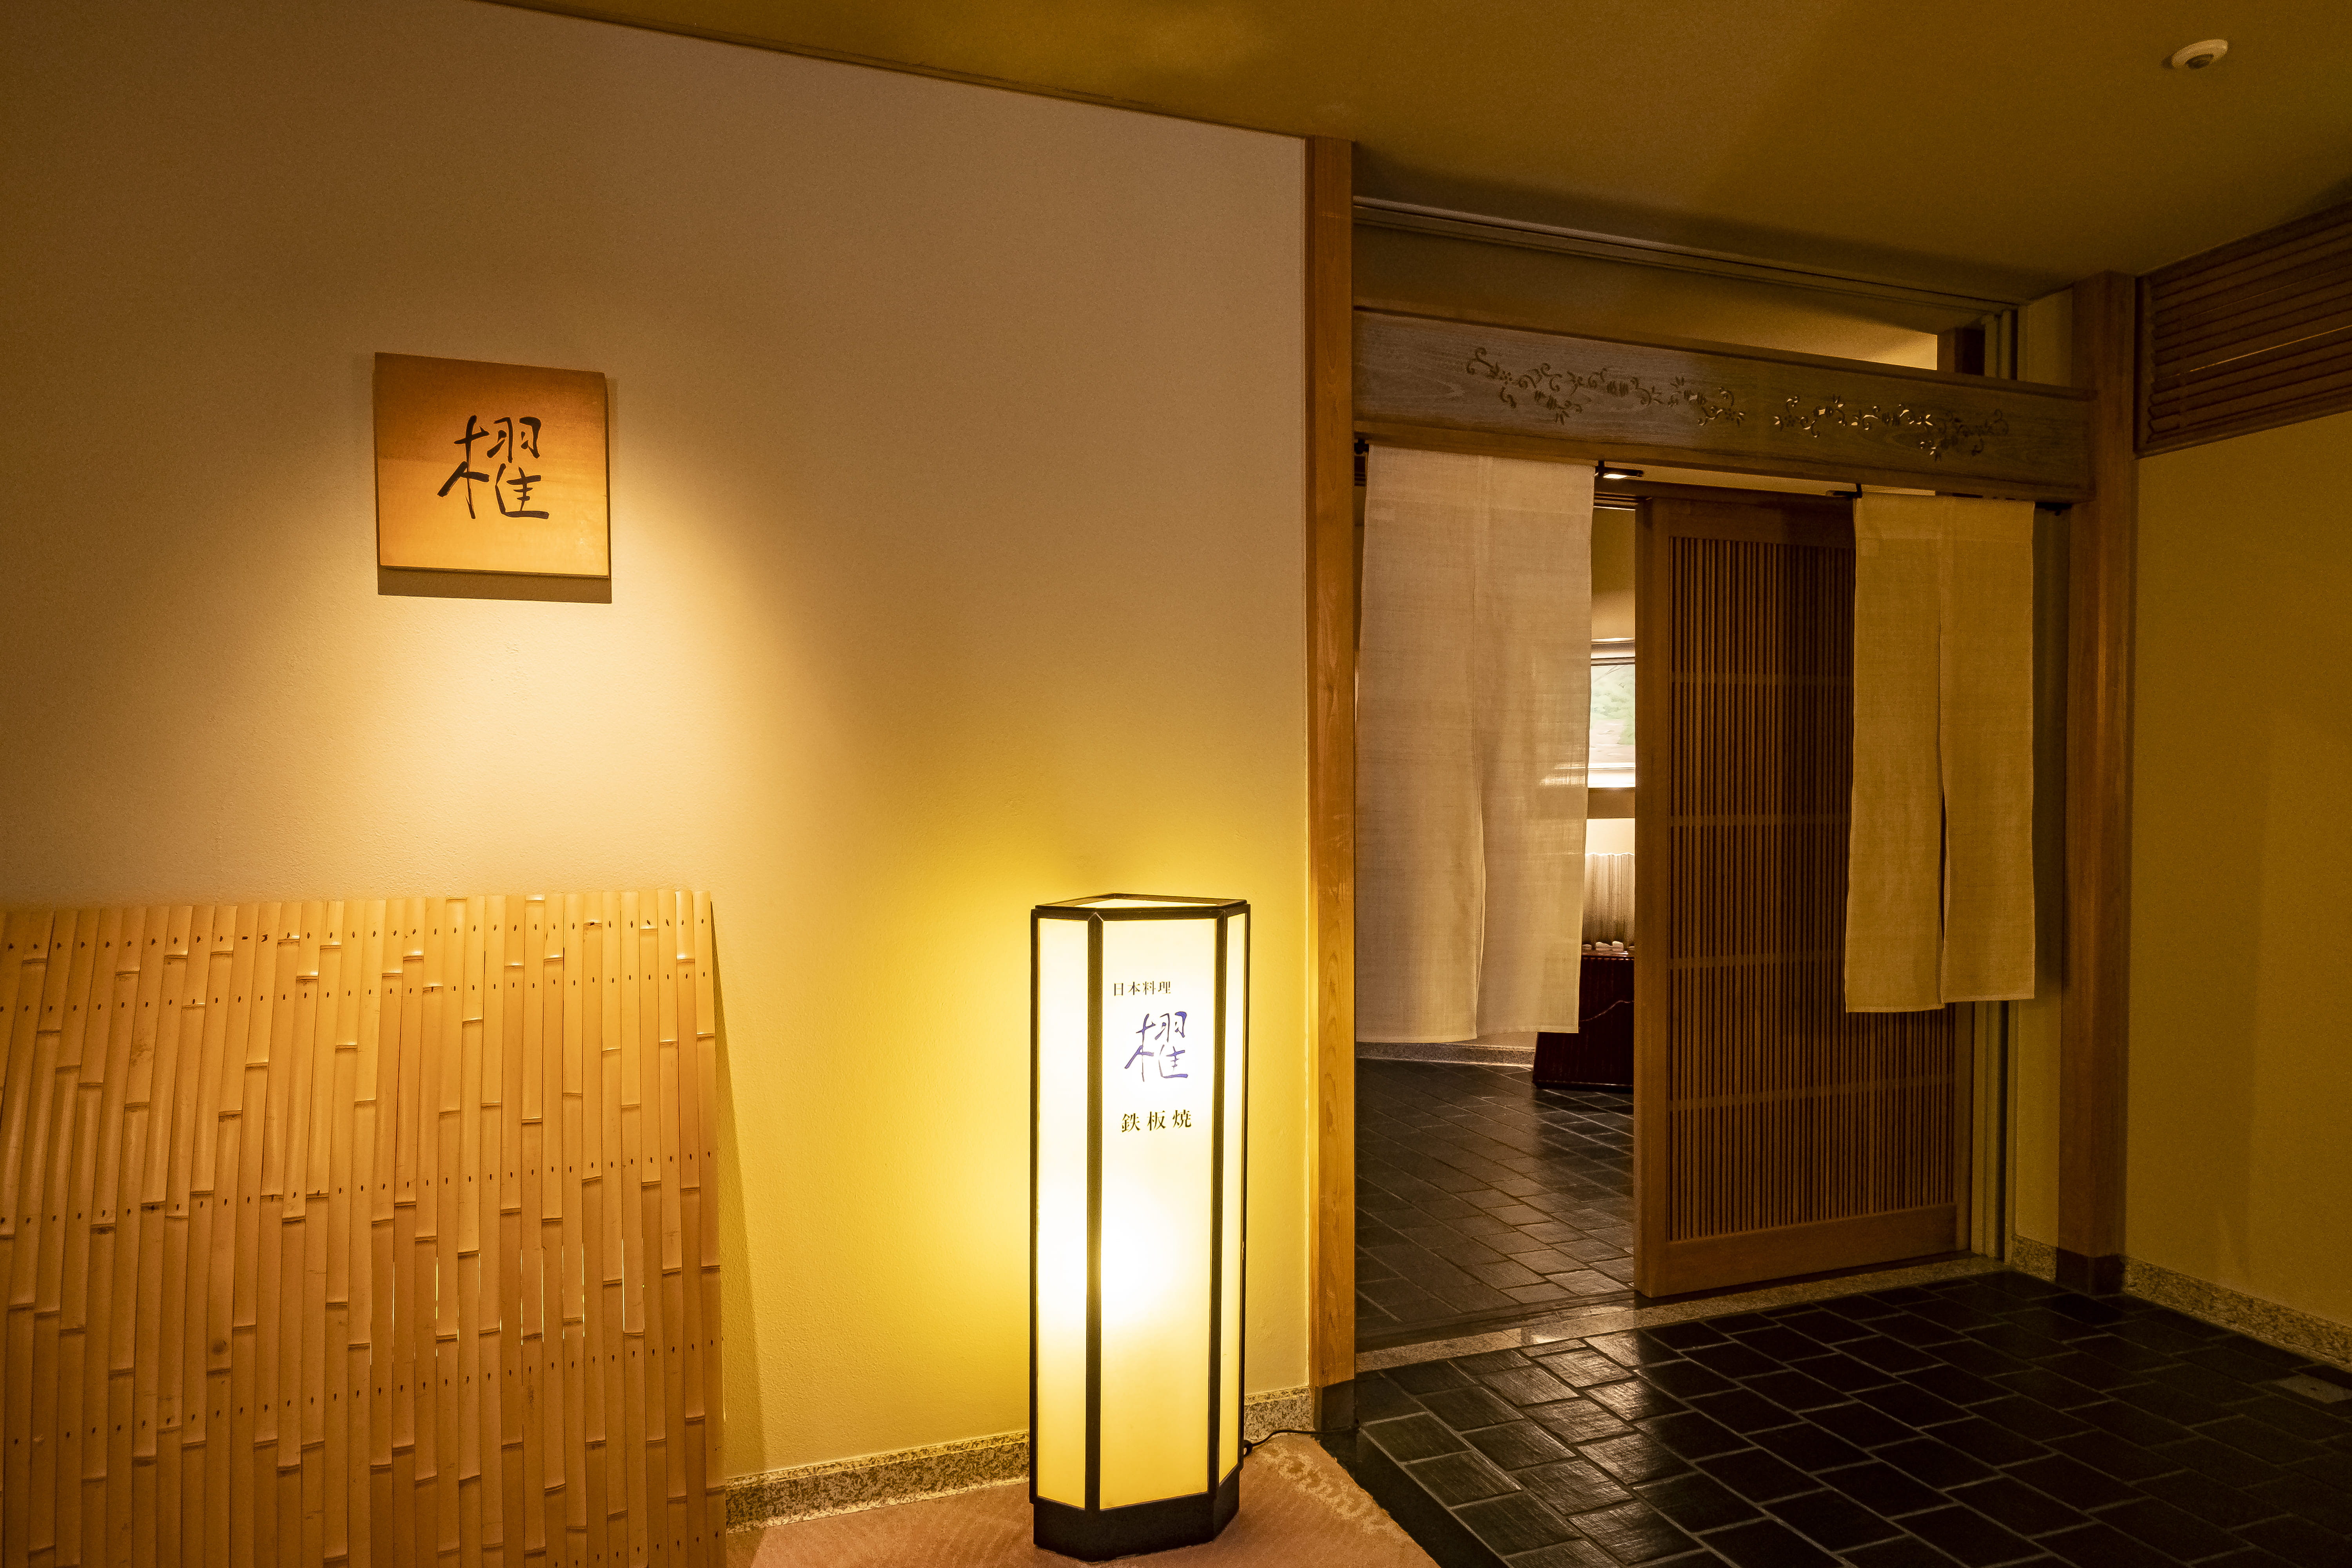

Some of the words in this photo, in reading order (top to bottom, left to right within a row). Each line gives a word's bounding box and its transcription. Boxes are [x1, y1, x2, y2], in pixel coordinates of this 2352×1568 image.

[437, 414, 550, 519] 櫂
[1114, 981, 1171, 996] 日本料理
[1124, 1011, 1188, 1082] 櫂
[1122, 1109, 1191, 1132] 鉄板焼
